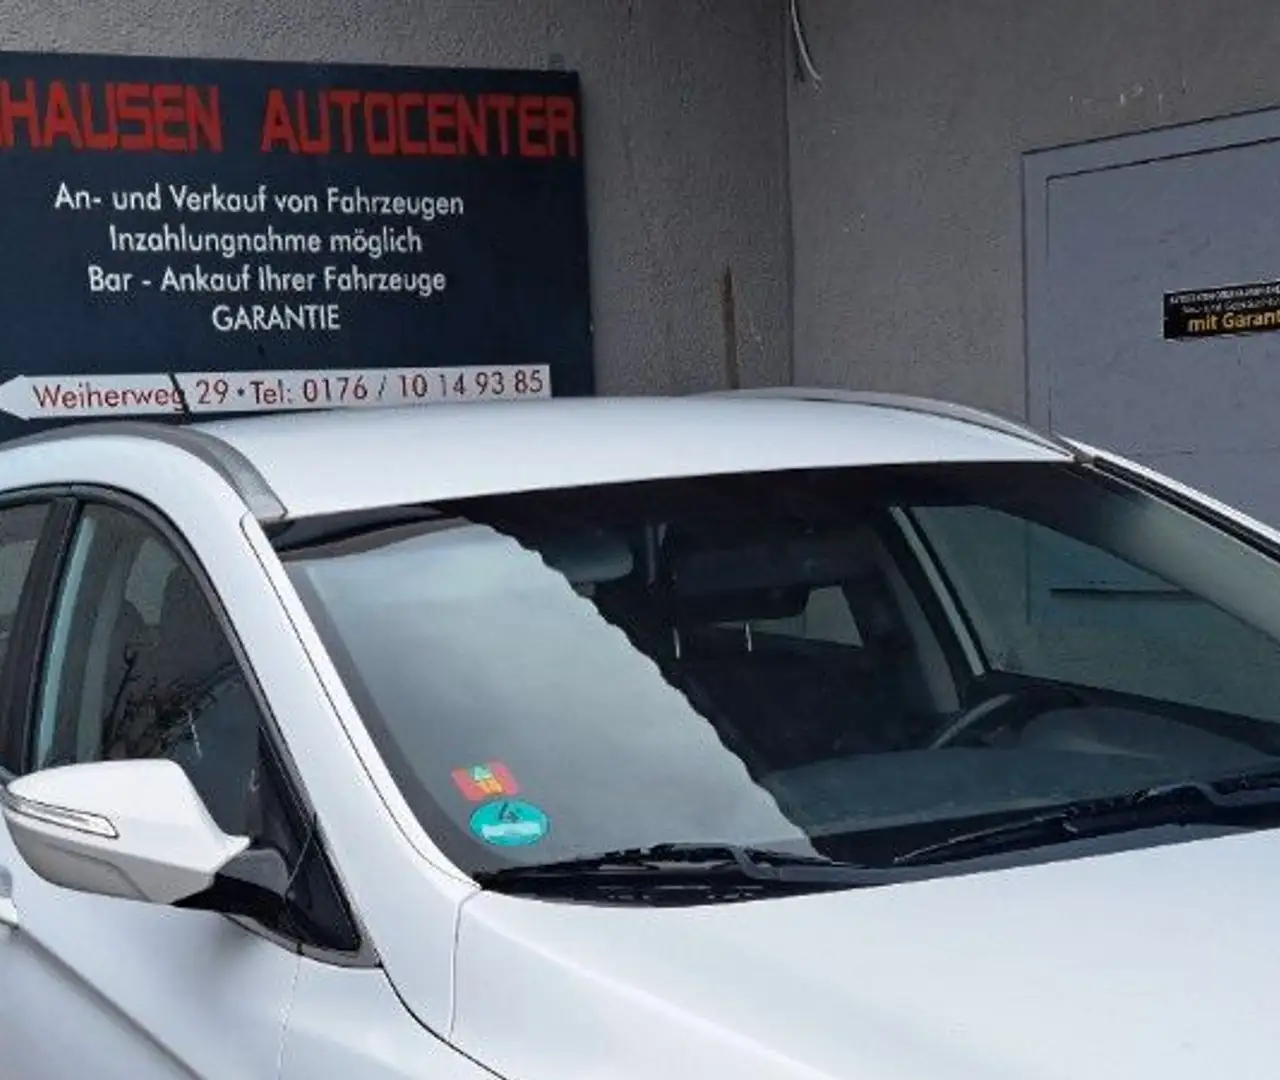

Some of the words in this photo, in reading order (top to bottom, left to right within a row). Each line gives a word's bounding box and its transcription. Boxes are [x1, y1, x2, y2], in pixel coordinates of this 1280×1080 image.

[260, 87, 577, 156] AUTOCENTER
[55, 182, 101, 210] An-
[112, 182, 161, 210] und
[169, 183, 267, 212] Verkauf
[275, 193, 318, 213] von
[327, 187, 464, 220] Fahrzeugen
[109, 223, 321, 258] Inzahlungnahme
[330, 228, 422, 258] möglich
[88, 265, 133, 292] Bar
[161, 264, 250, 292] Ankauf
[258, 265, 315, 291] Ihrer
[324, 265, 446, 296] Fahrzeuge
[212, 304, 341, 331] GARANTIE
[1187, 315, 1217, 333] mit
[32, 381, 185, 411] Weiherweg
[195, 380, 229, 406] 29
[304, 376, 368, 402] 0176
[398, 374, 428, 399] 10
[440, 373, 467, 396] 14
[475, 371, 505, 396] 93
[514, 370, 544, 395] 85
